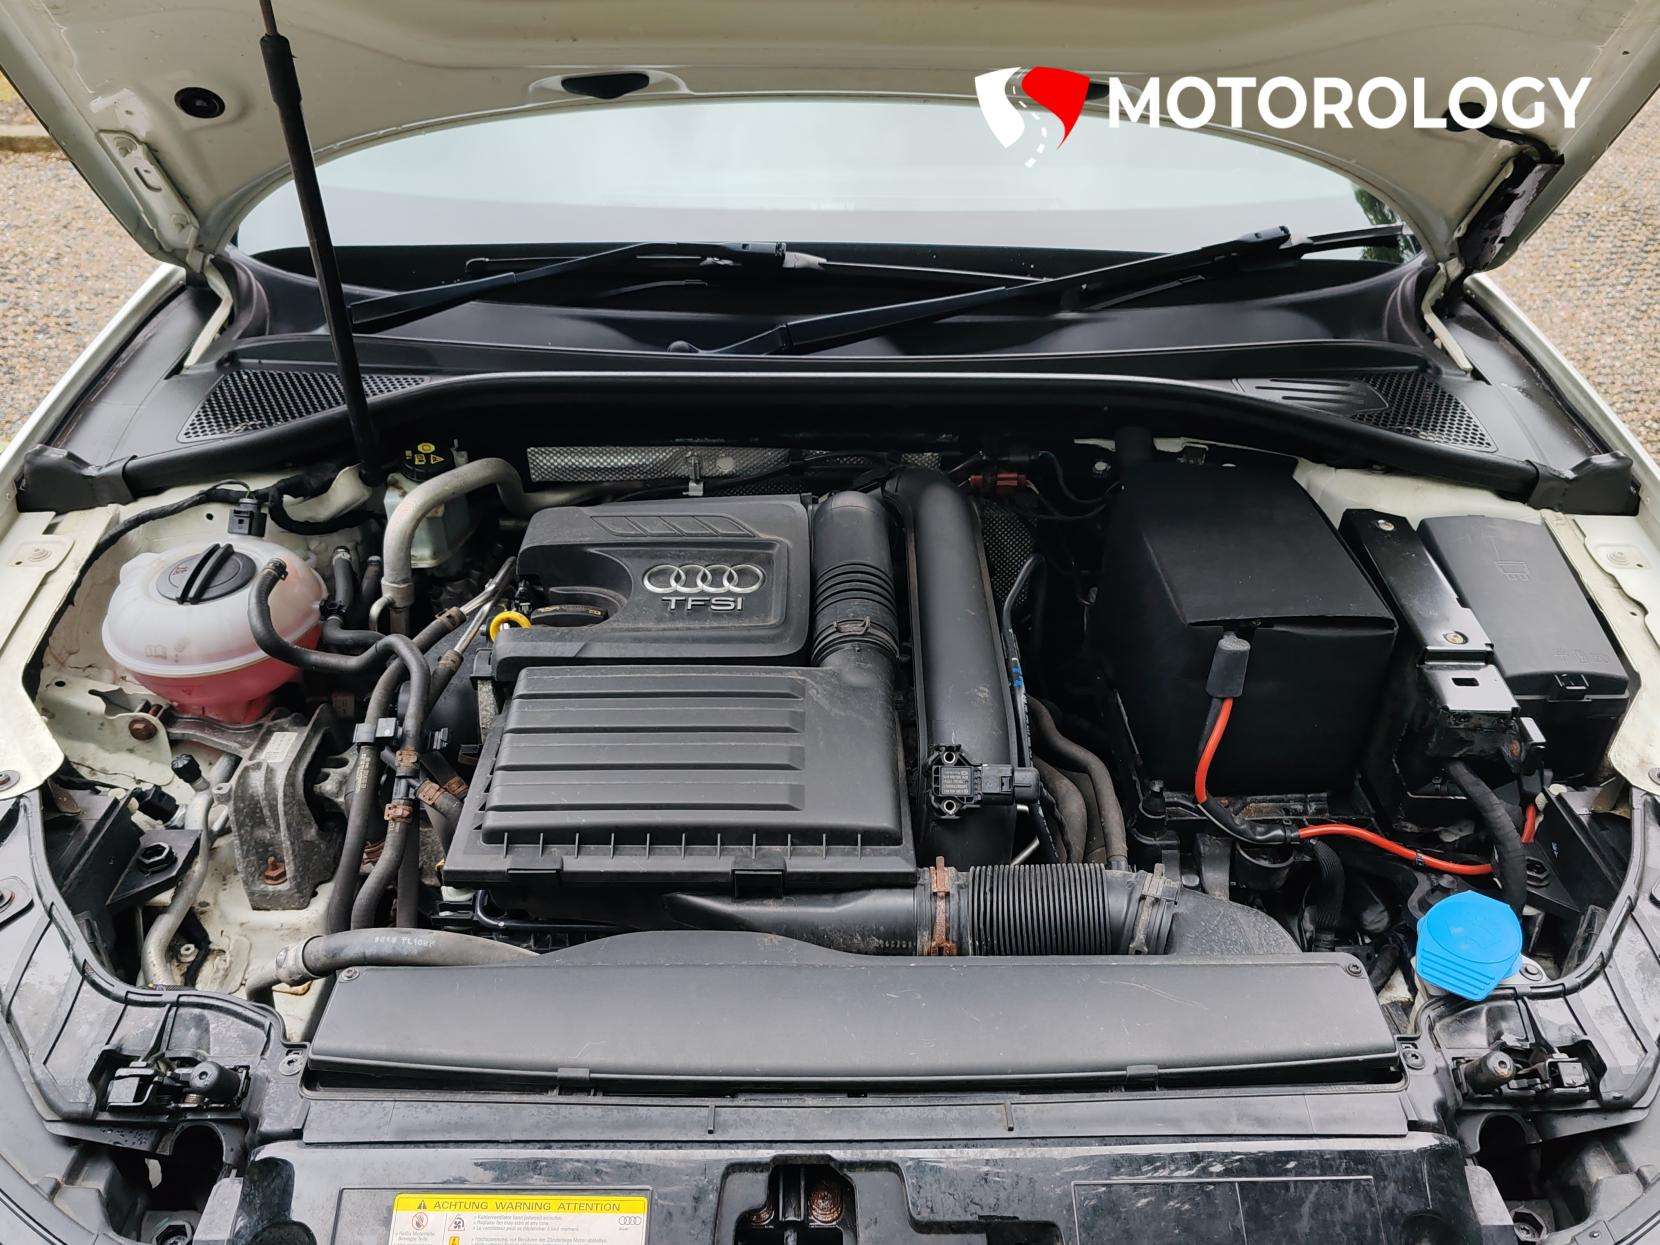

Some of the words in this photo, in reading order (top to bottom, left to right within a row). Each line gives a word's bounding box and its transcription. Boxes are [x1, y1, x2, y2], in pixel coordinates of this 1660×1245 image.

[662, 596, 743, 611] TFSI
[433, 1201, 489, 1210] ACHTUNG
[495, 1201, 551, 1211] WARNING
[557, 1202, 621, 1212] ATTENTION
